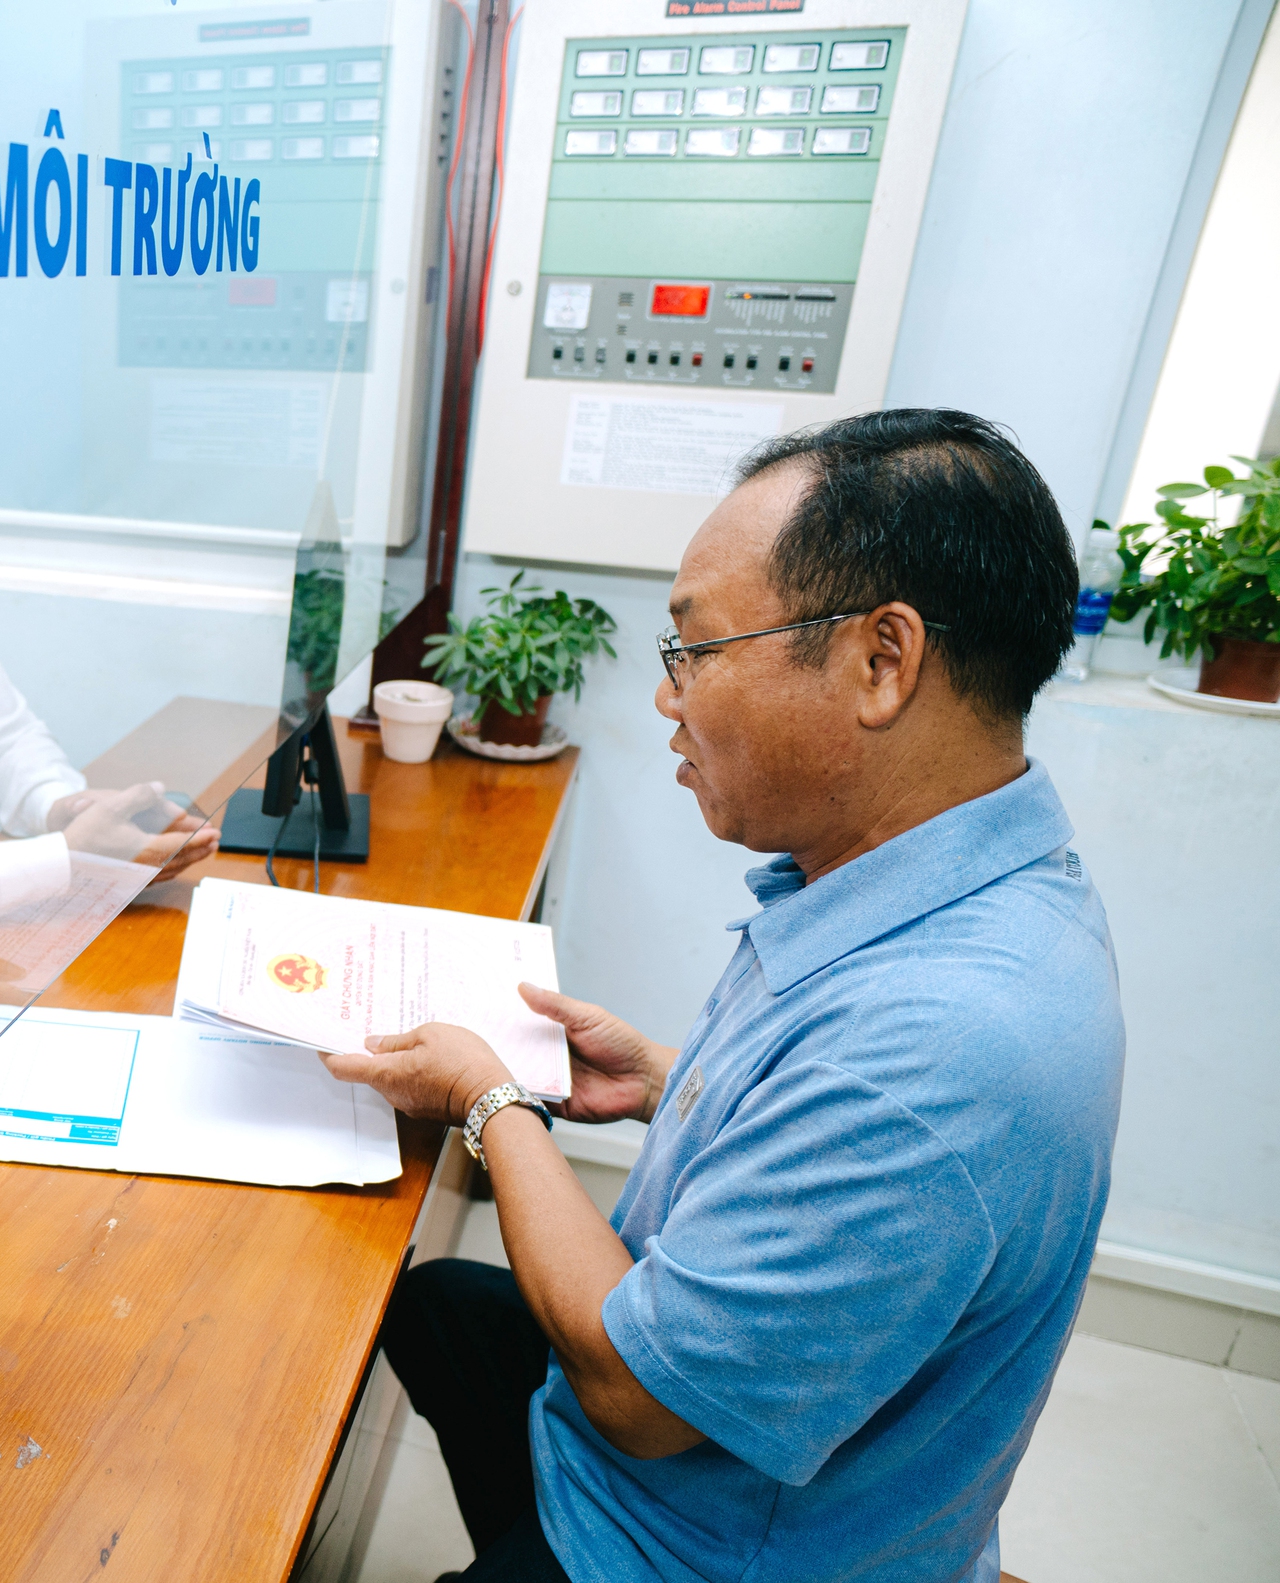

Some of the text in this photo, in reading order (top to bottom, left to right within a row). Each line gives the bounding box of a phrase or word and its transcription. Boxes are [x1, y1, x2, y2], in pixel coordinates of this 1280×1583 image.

[669, 0, 801, 15] Fire Alarm Control Panel
[104, 132, 261, 277] TRƯỜNG
